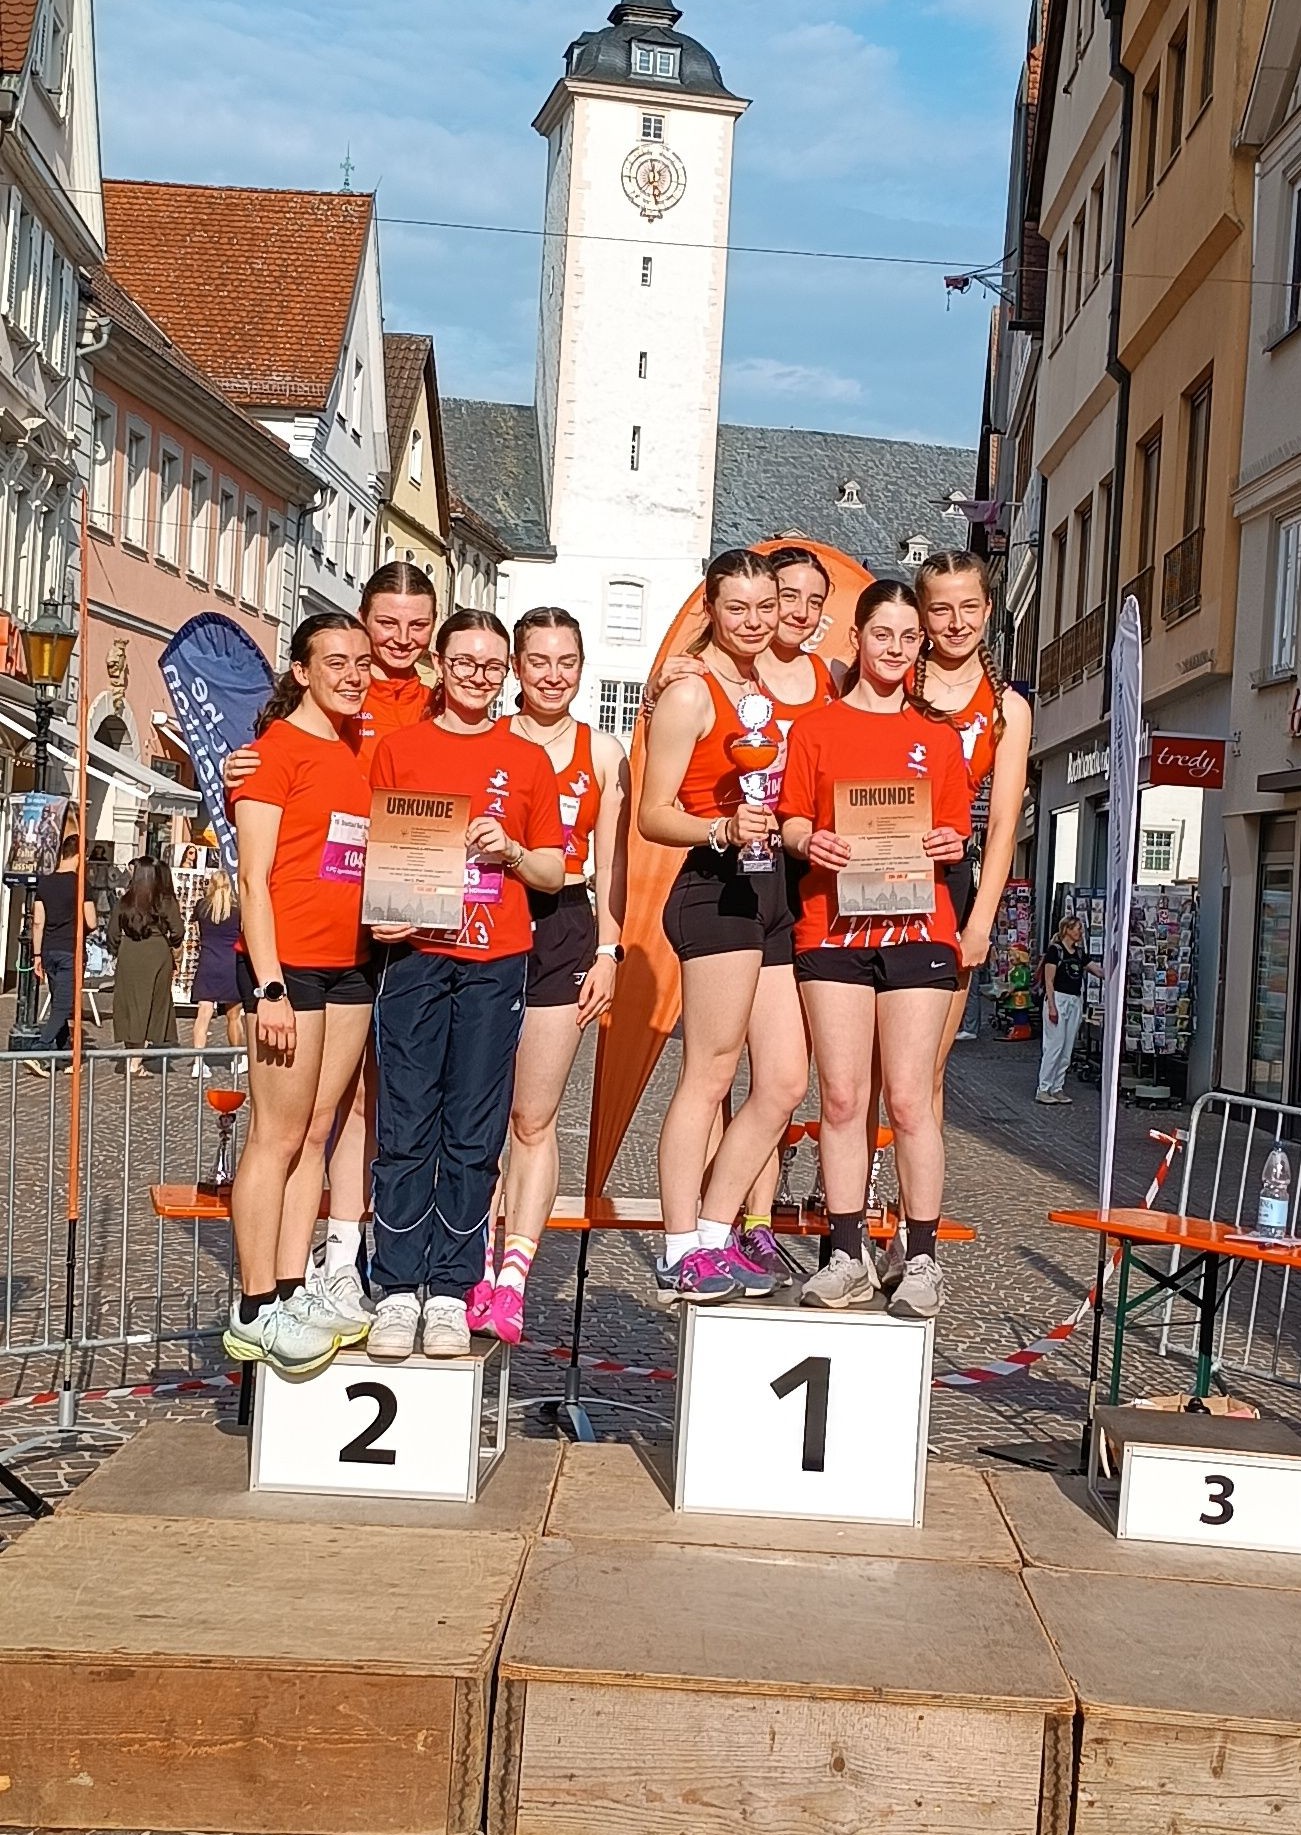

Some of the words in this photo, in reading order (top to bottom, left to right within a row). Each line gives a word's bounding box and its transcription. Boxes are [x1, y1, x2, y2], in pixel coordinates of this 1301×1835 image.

[1157, 746, 1220, 778] tredy
[386, 796, 454, 819] URKUNDE
[849, 786, 915, 807] URKUNDE
[344, 850, 365, 868] 104
[338, 1382, 397, 1466] 2
[769, 1356, 831, 1473] 1
[1199, 1476, 1236, 1526] 3
